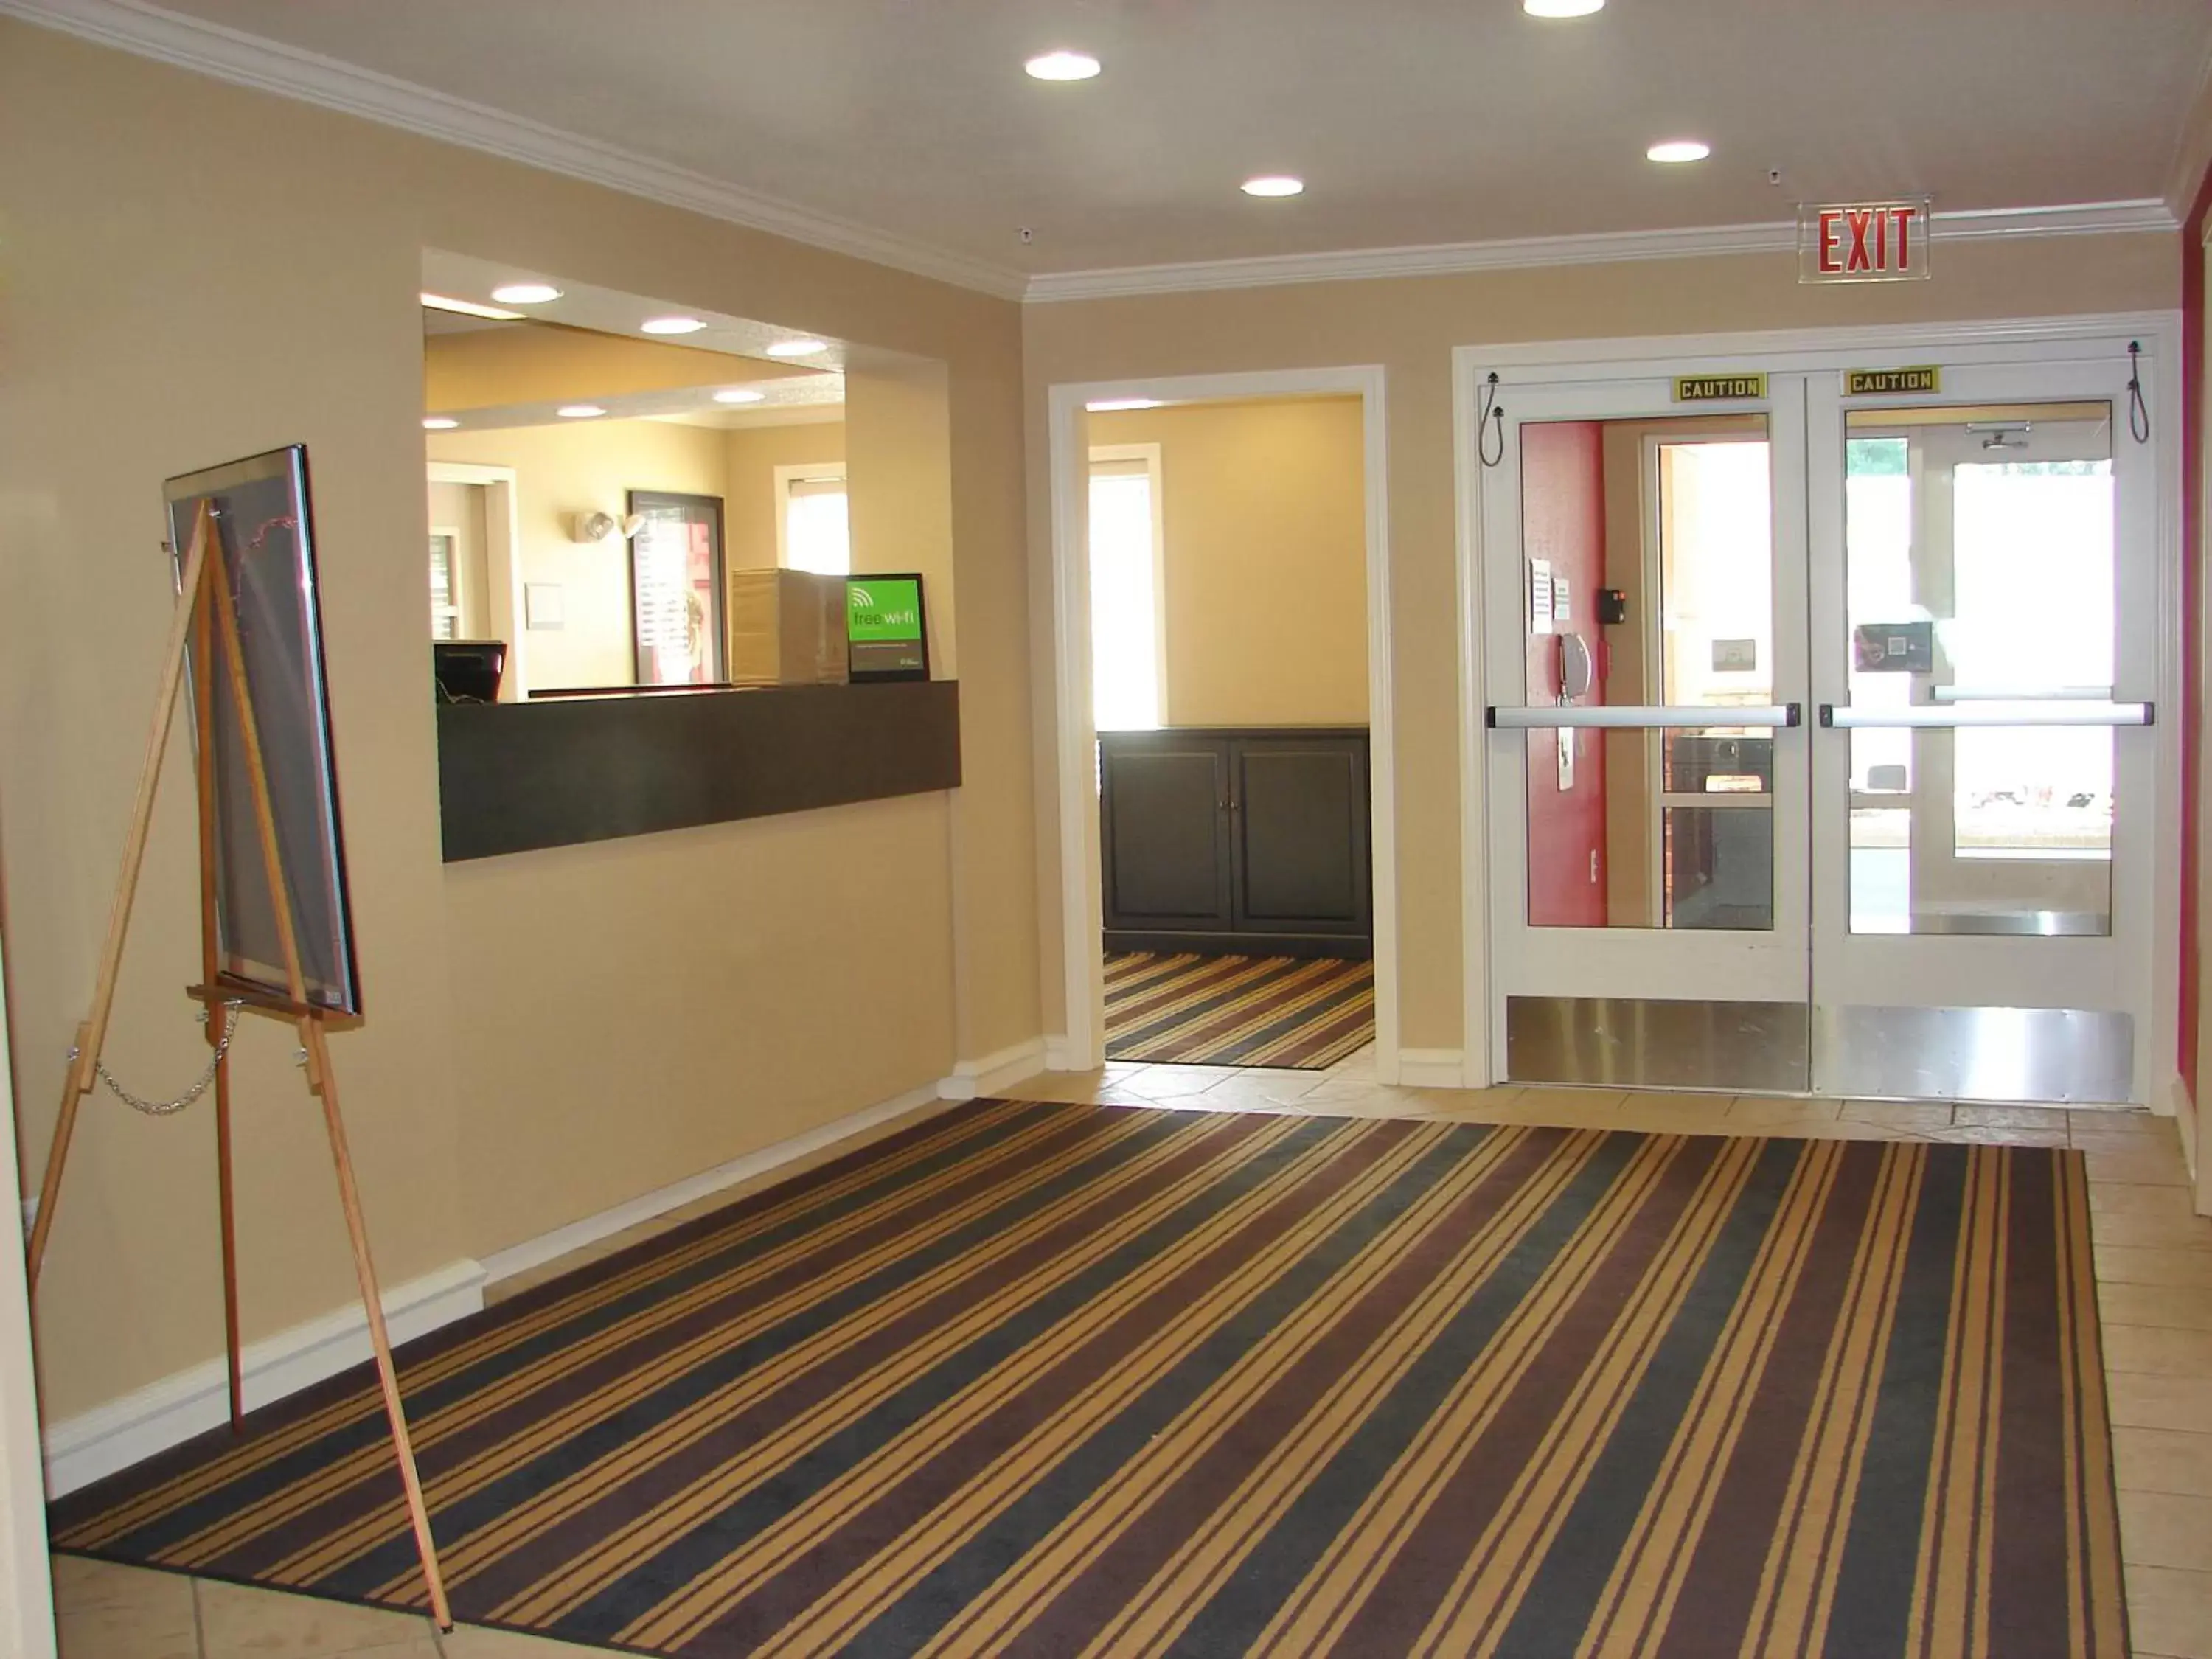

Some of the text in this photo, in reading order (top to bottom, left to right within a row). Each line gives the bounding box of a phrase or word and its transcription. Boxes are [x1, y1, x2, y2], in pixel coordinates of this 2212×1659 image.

[1819, 207, 1916, 274] EXIT
[1682, 380, 1758, 397] CAUTION
[1852, 372, 1931, 391] CAUTION
[854, 611, 882, 625] free
